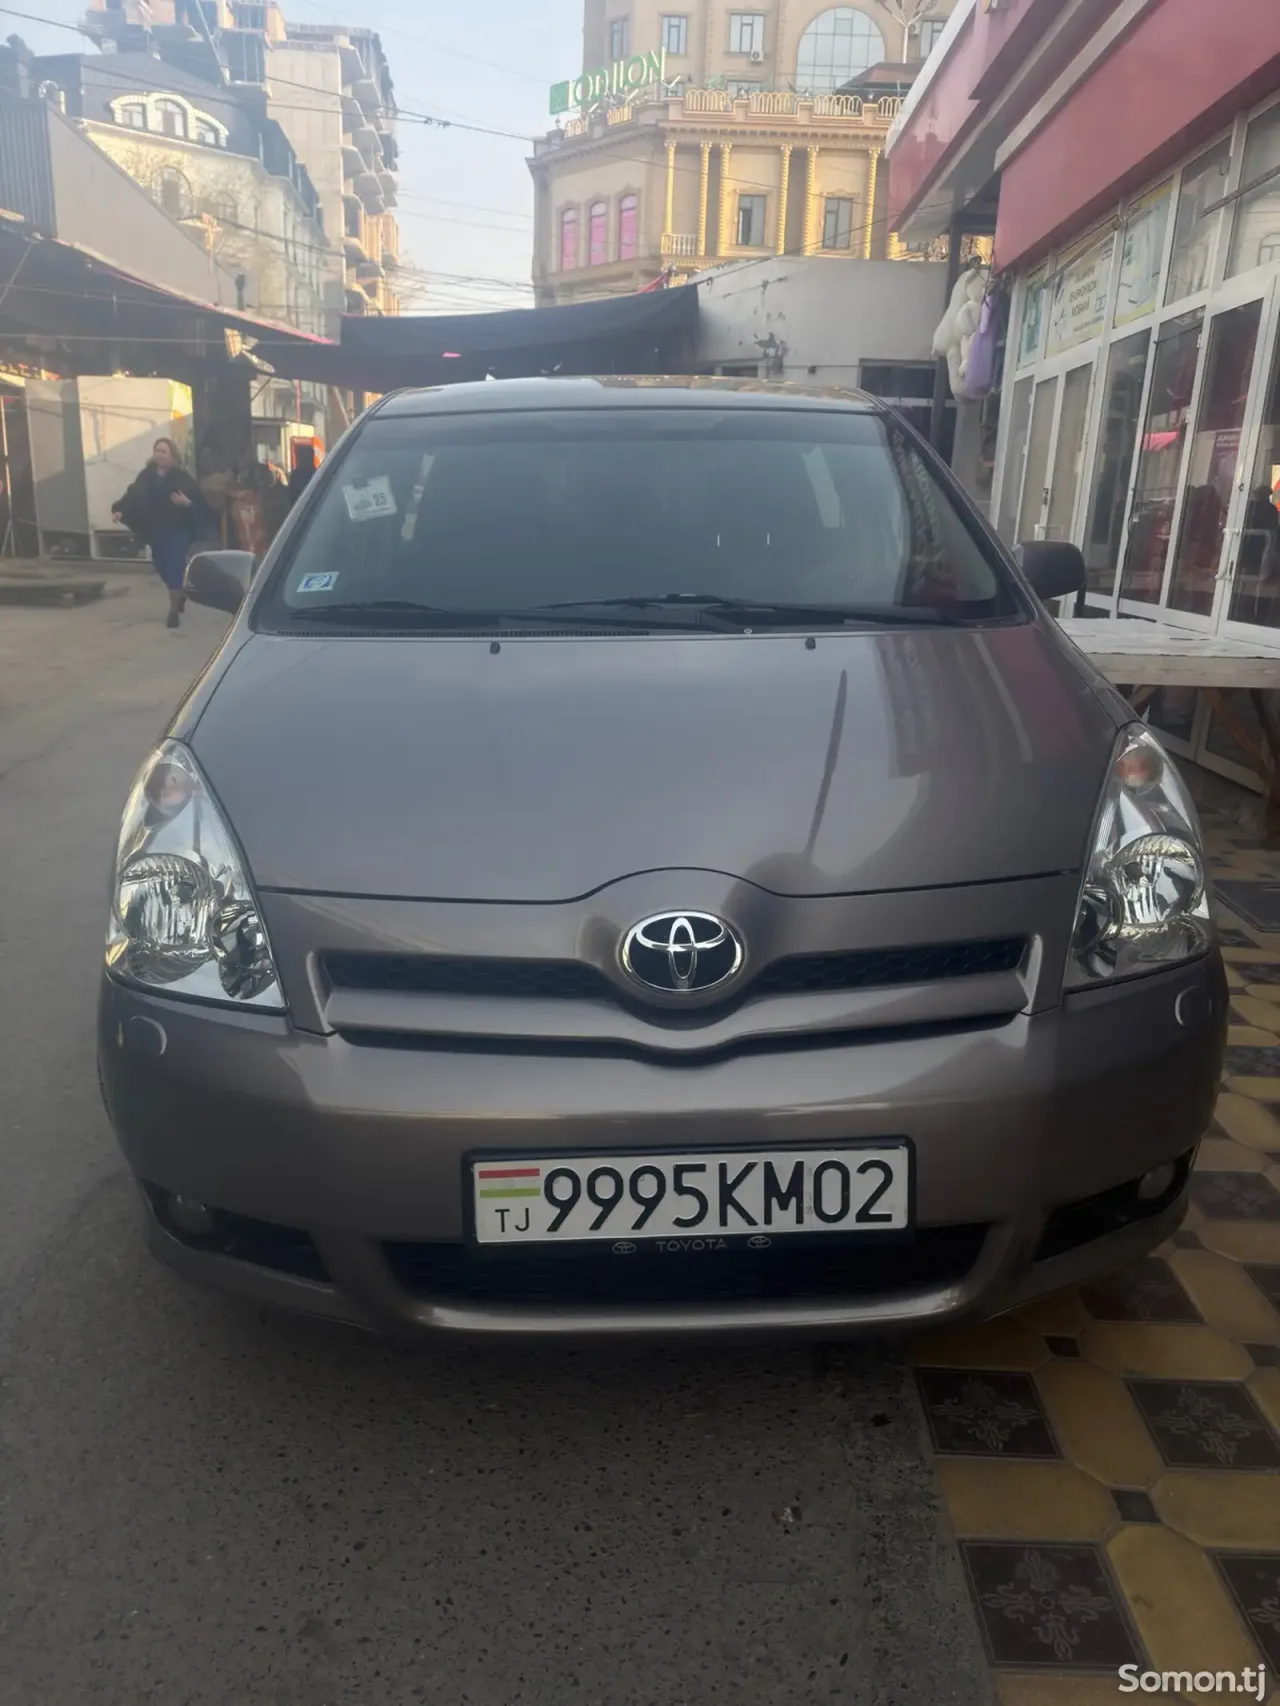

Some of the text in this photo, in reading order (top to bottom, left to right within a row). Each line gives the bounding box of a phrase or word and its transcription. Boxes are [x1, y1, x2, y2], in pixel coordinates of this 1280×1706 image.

[372, 492, 388, 506] 25
[544, 1159, 894, 1232] 9995KM02
[494, 1208, 531, 1234] TJ
[655, 1239, 728, 1253] TOYOTA
